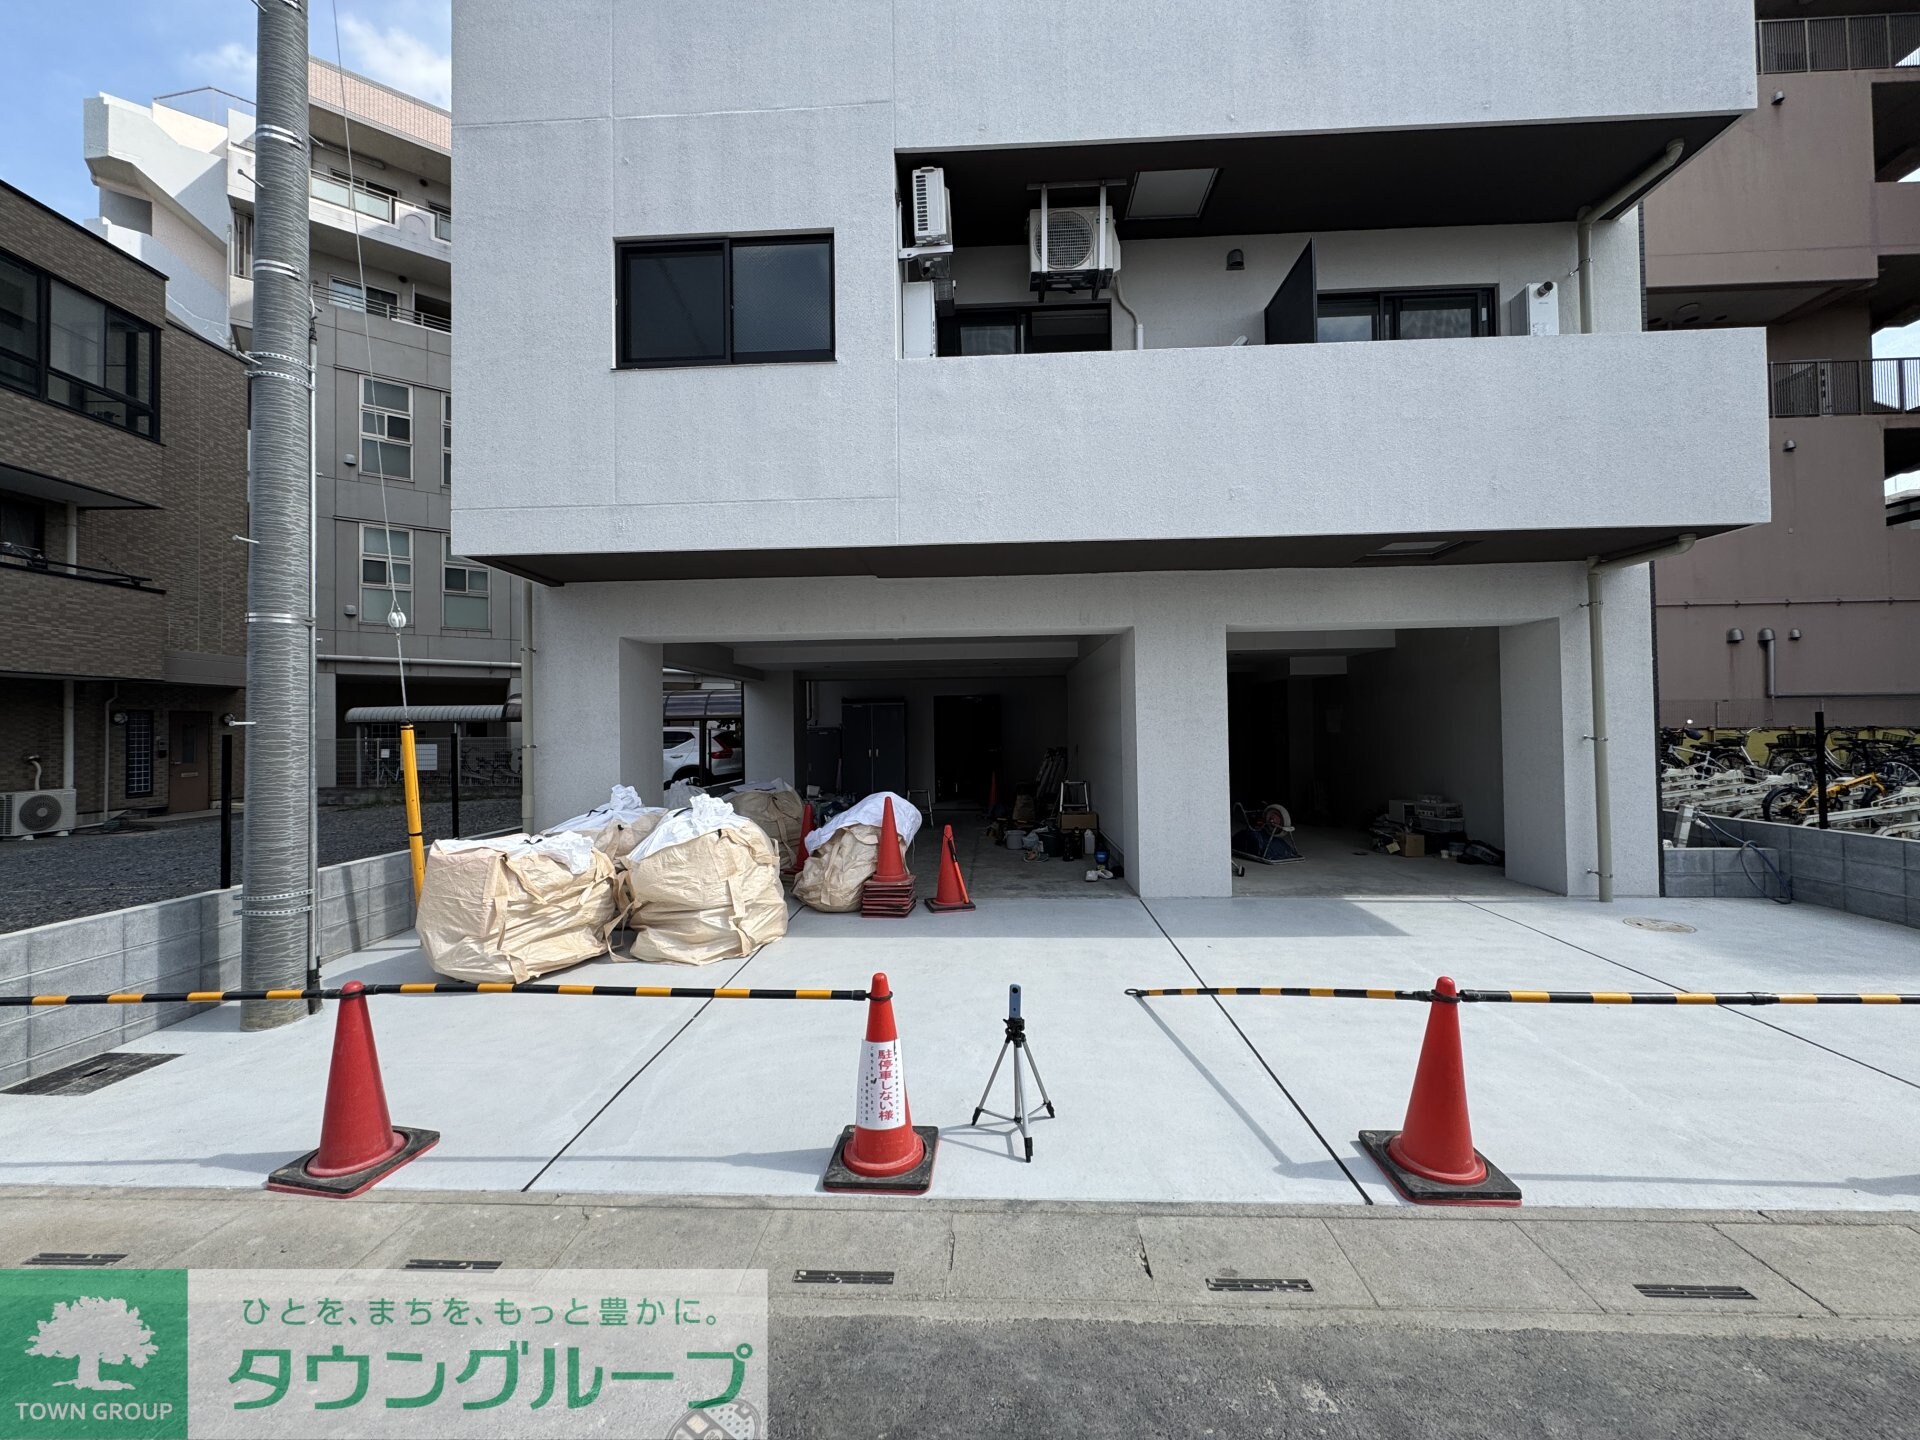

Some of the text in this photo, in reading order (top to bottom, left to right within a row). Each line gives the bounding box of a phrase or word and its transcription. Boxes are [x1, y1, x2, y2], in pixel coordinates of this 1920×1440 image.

[878, 1049, 894, 1121] 駐停車しない様
